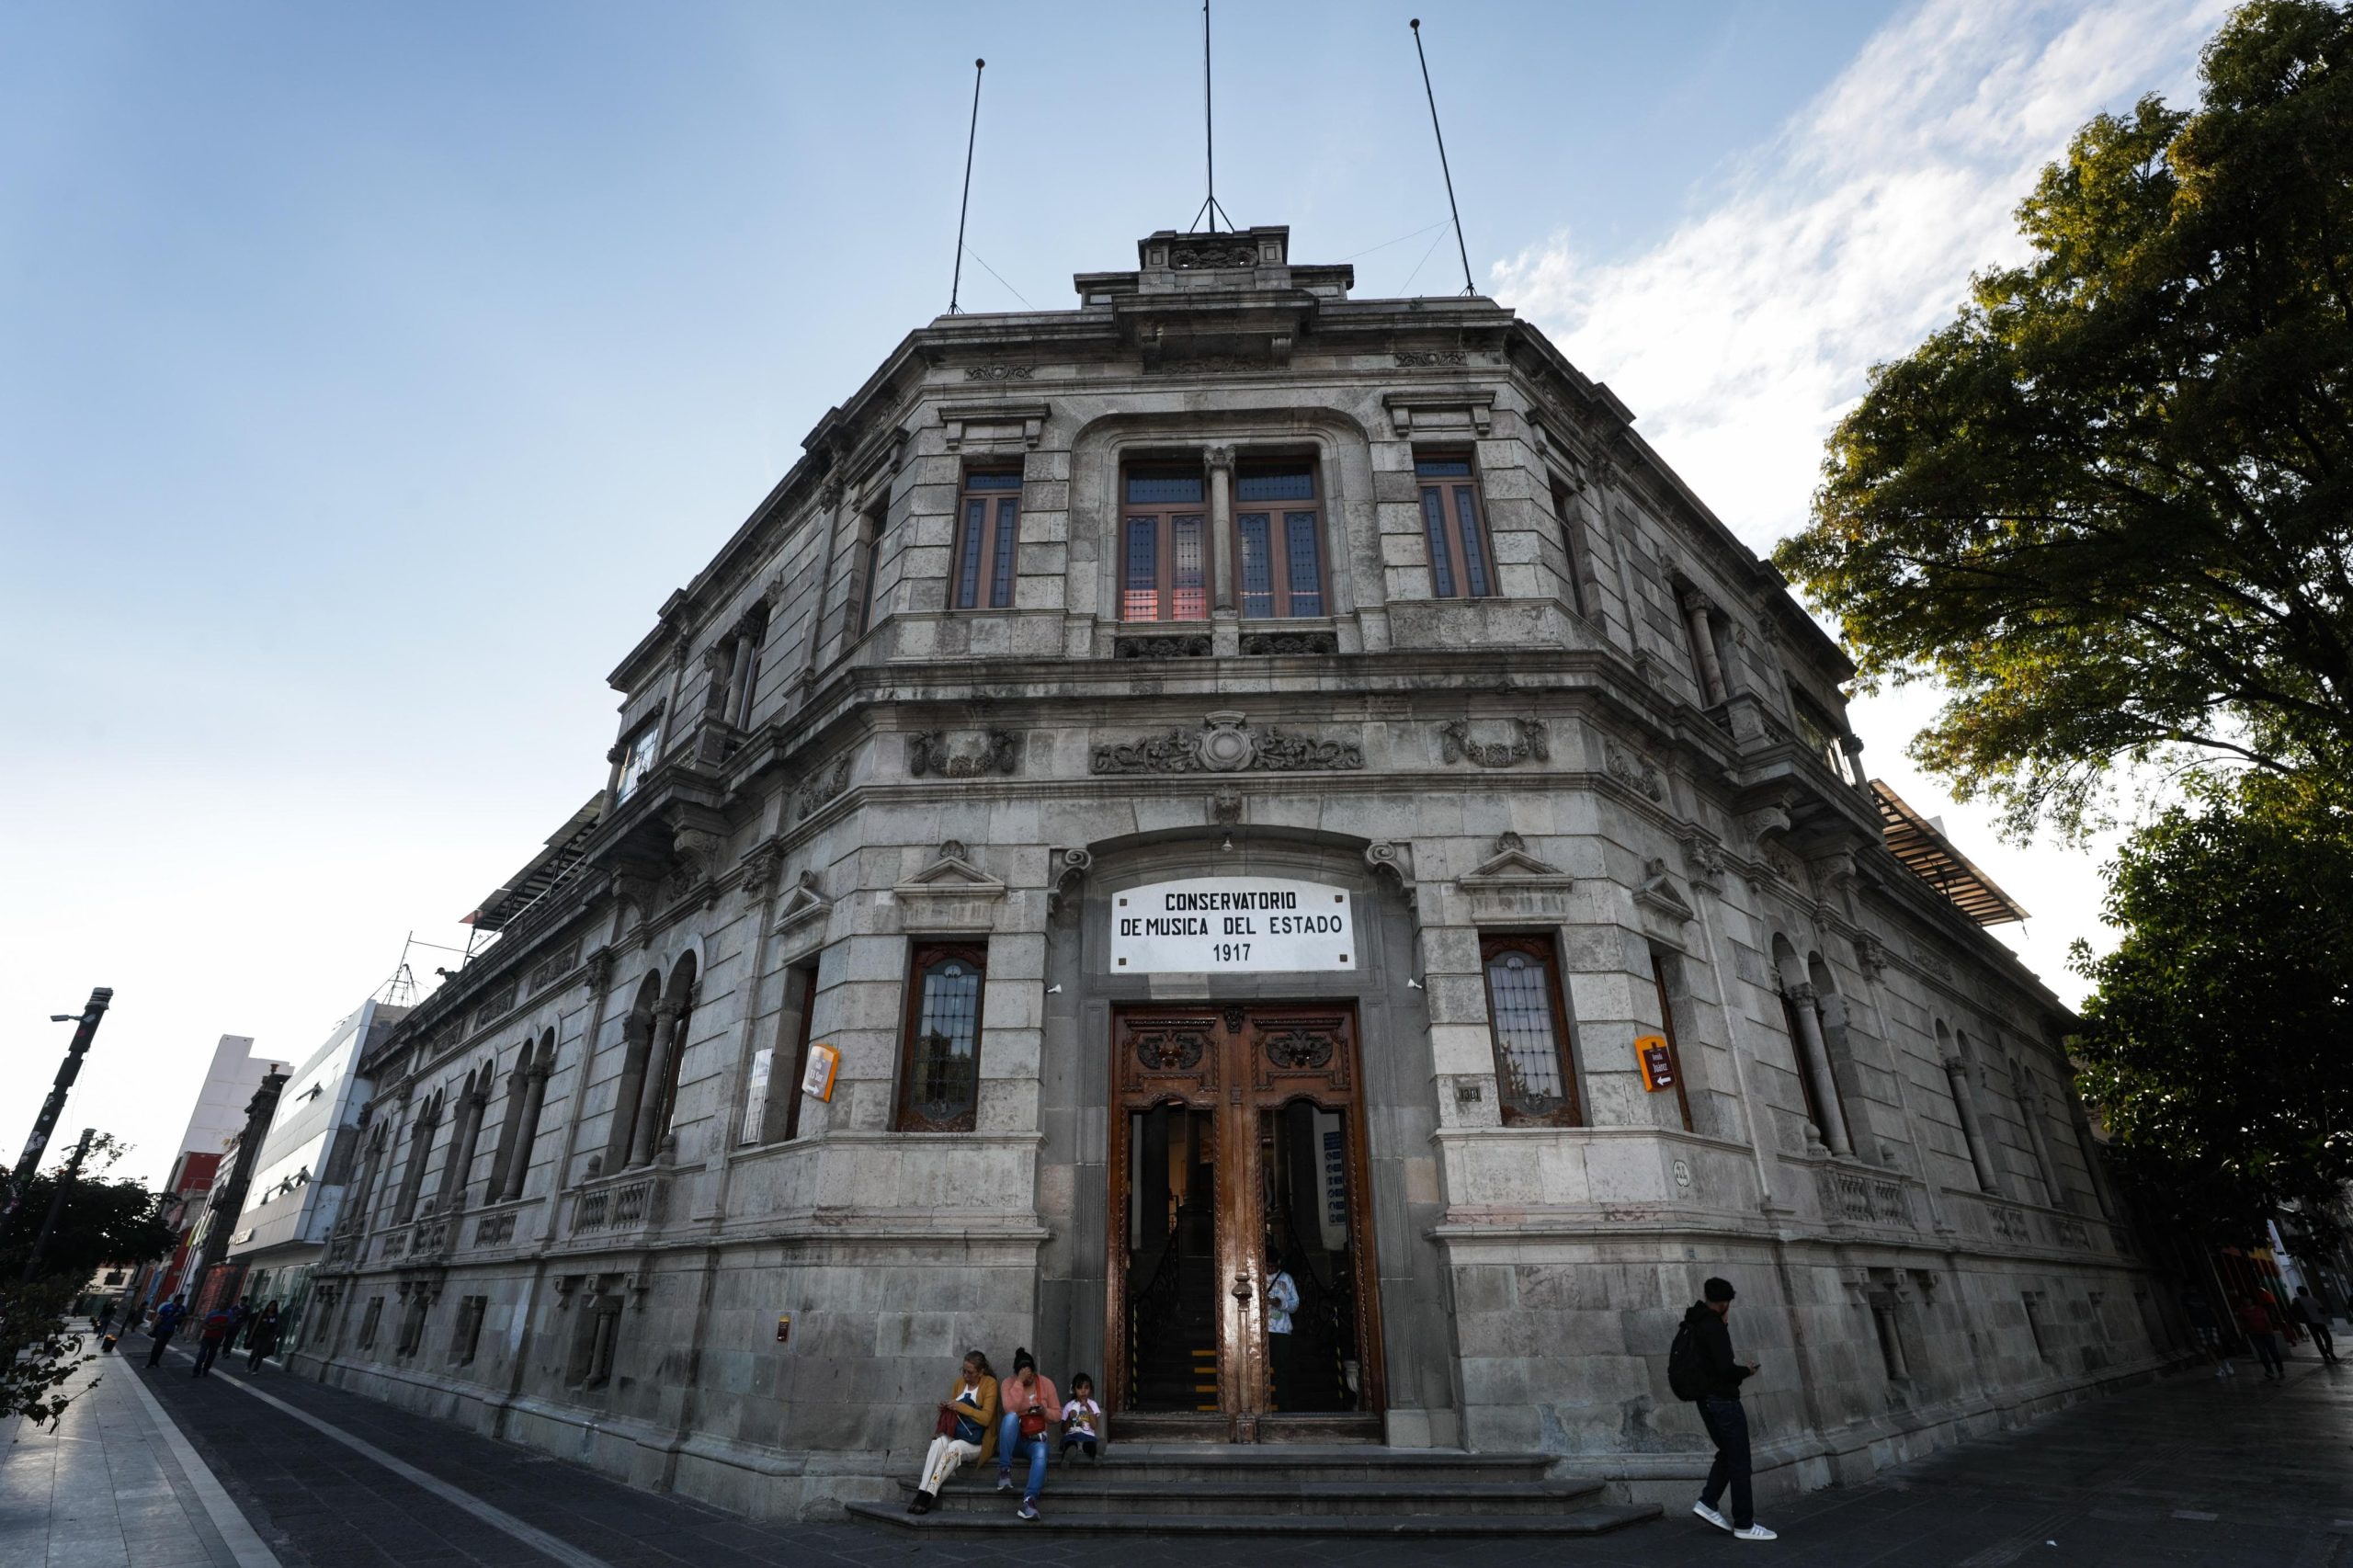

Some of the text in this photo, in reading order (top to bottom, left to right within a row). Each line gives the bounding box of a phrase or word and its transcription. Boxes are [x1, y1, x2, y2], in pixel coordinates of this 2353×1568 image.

[1165, 891, 1297, 912] CONSERVATORIO
[1120, 915, 1343, 937] DE MUSICA DEL ESTADO
[1212, 943, 1252, 962] 1917
